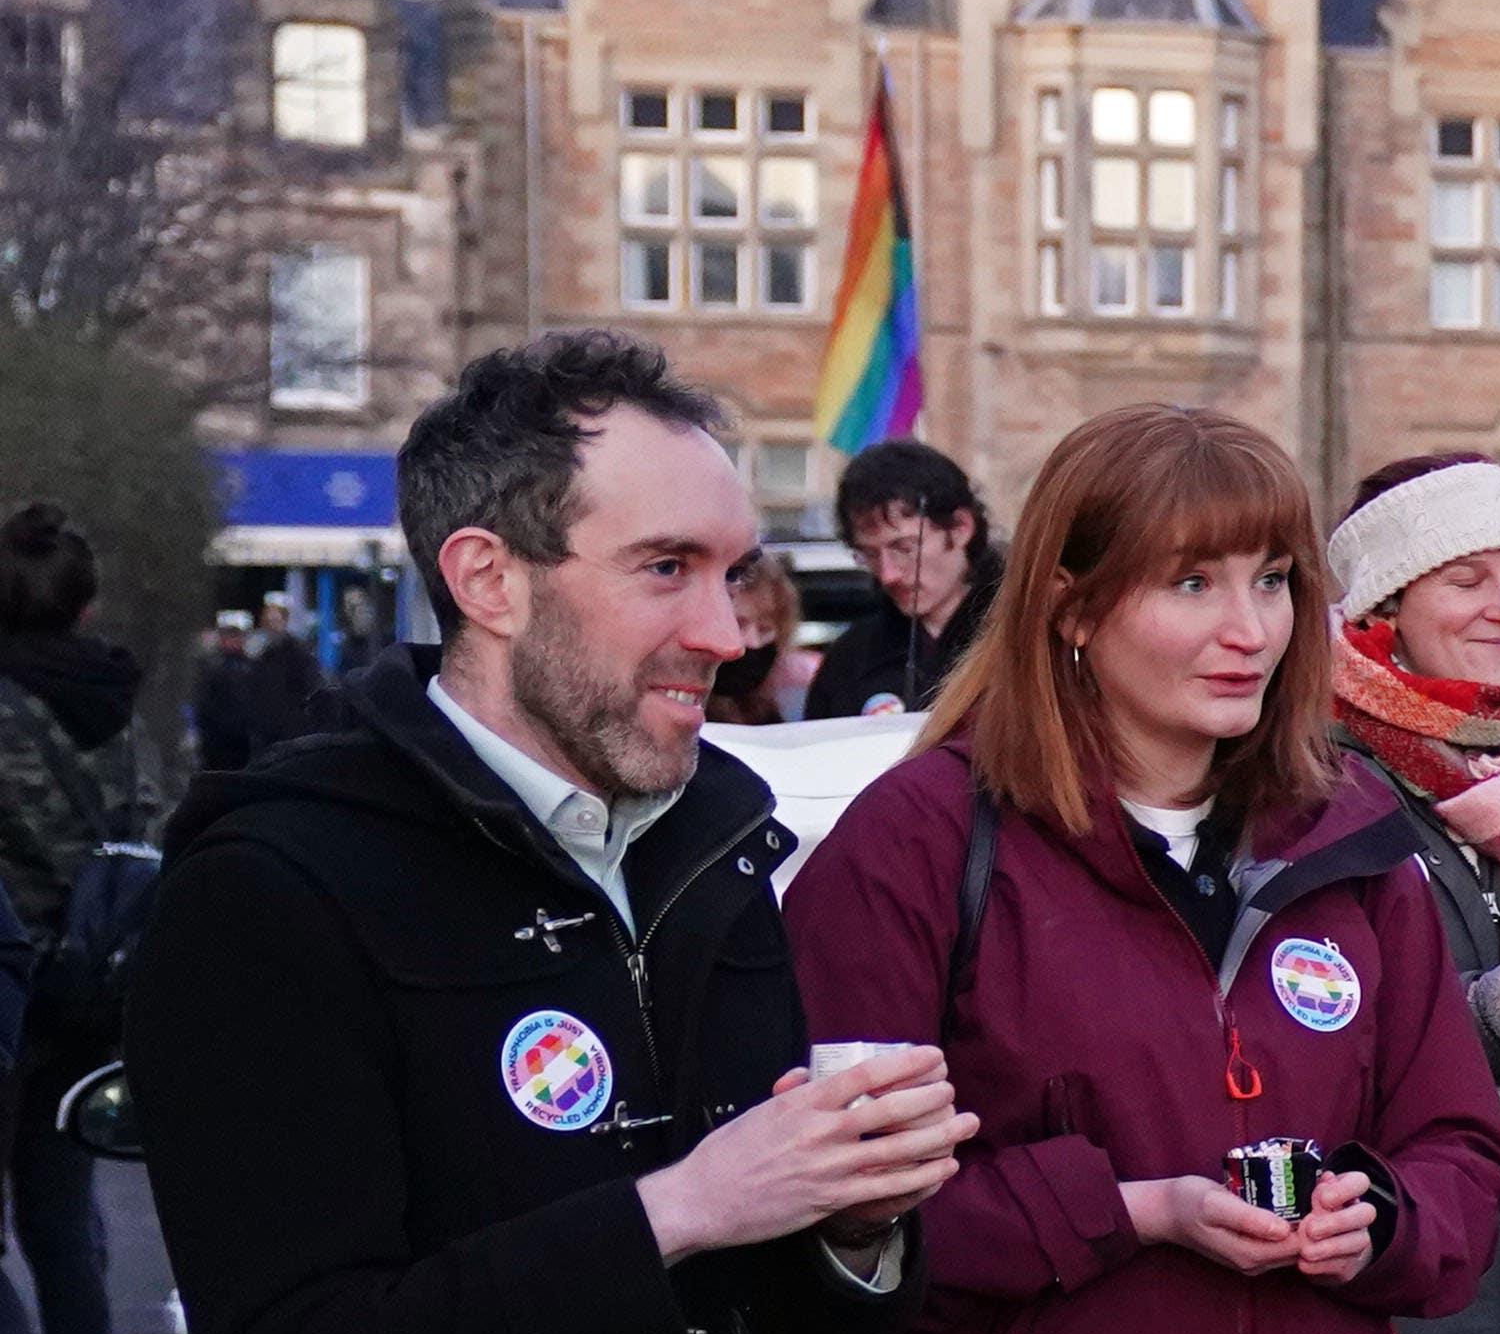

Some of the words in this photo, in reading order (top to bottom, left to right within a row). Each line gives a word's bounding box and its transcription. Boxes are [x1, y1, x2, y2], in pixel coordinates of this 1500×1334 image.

[508, 1020, 542, 1094] TRANSPHOBIA
[544, 1017, 554, 1027] IS
[556, 1020, 585, 1037] JUST
[525, 1100, 581, 1125] RECYCLED
[582, 1044, 607, 1118] HOMOPHOBIA
